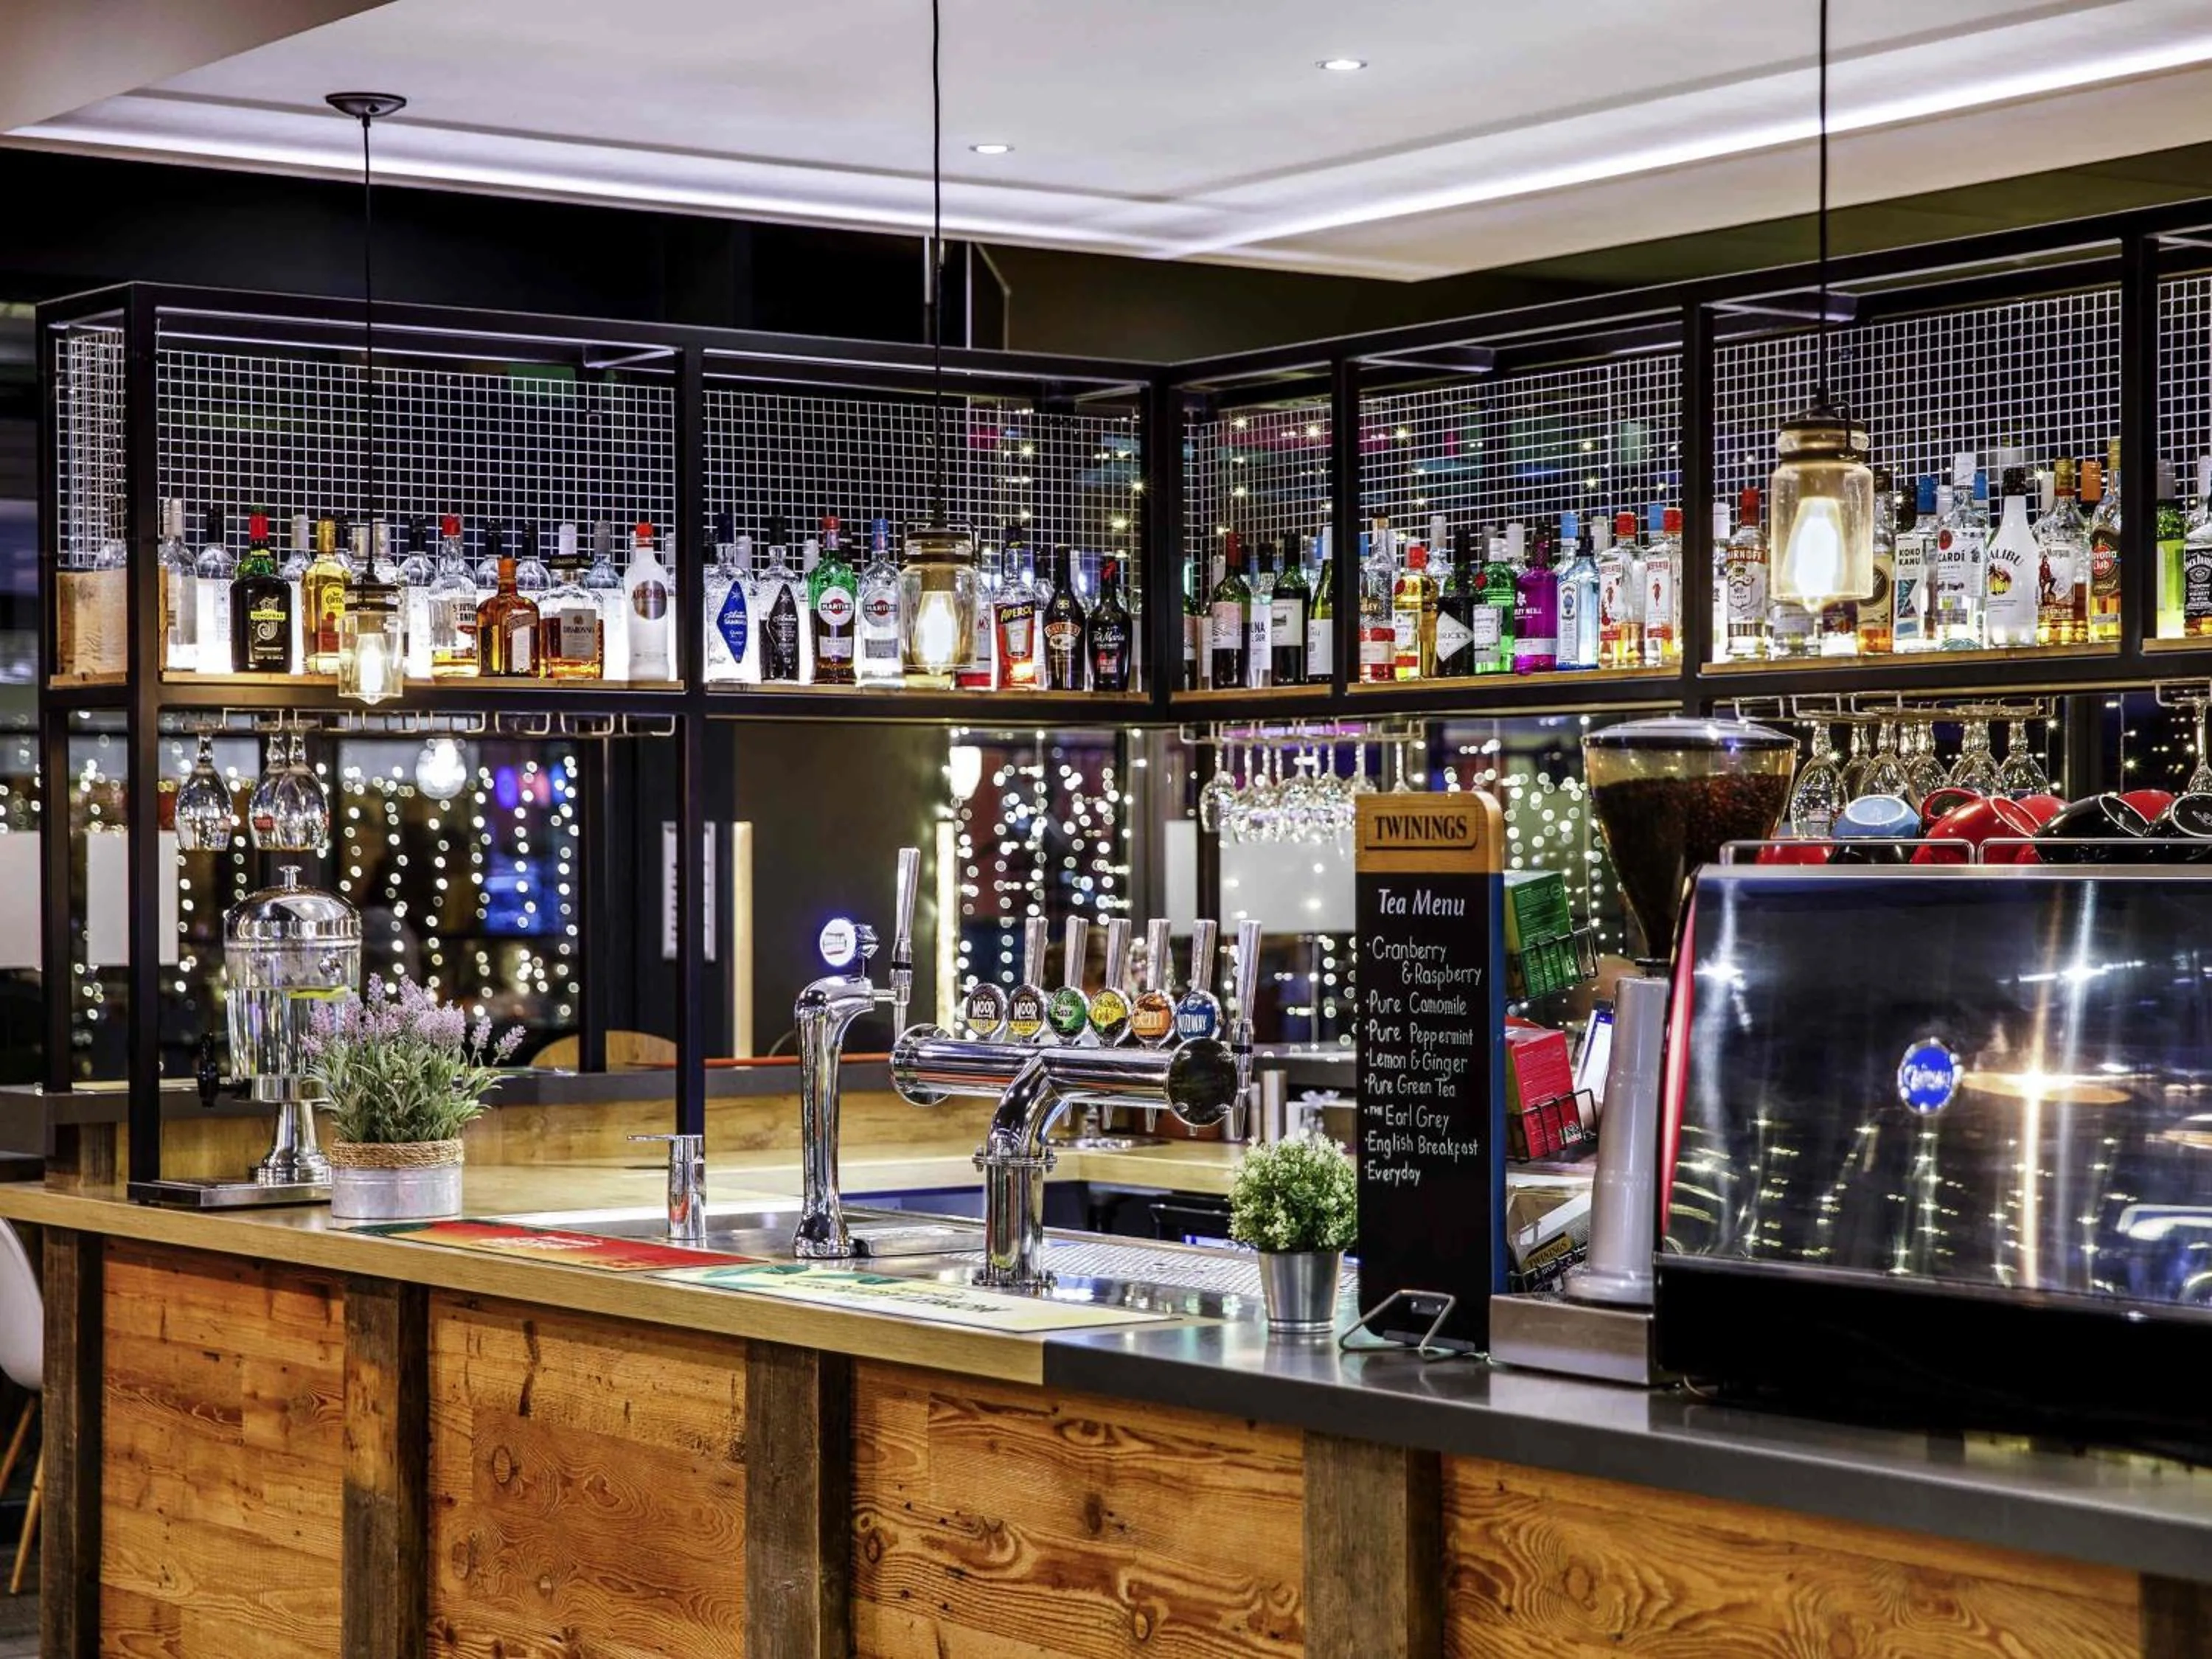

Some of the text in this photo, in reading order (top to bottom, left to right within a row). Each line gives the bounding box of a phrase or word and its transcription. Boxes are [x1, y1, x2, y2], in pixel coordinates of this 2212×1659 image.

[1899, 548, 1921, 557] KOKO
[1374, 815, 1467, 841] TWININGS
[1378, 888, 1465, 916] Tea Menu
[1372, 935, 1446, 962] Cranberry
[1414, 963, 1481, 990] Raspberry
[1369, 989, 1467, 1016] Pure Camomile
[1369, 1018, 1473, 1051] Pure Peppermint
[1369, 1046, 1407, 1069] Lemon
[1422, 1051, 1468, 1079] Ginger
[1368, 1073, 1455, 1098] Pure Green Tea
[1385, 1103, 1412, 1127] Earl
[1416, 1105, 1450, 1136] Grey
[1368, 1130, 1478, 1163] English Breakfast
[1368, 1159, 1421, 1186] Everyday
